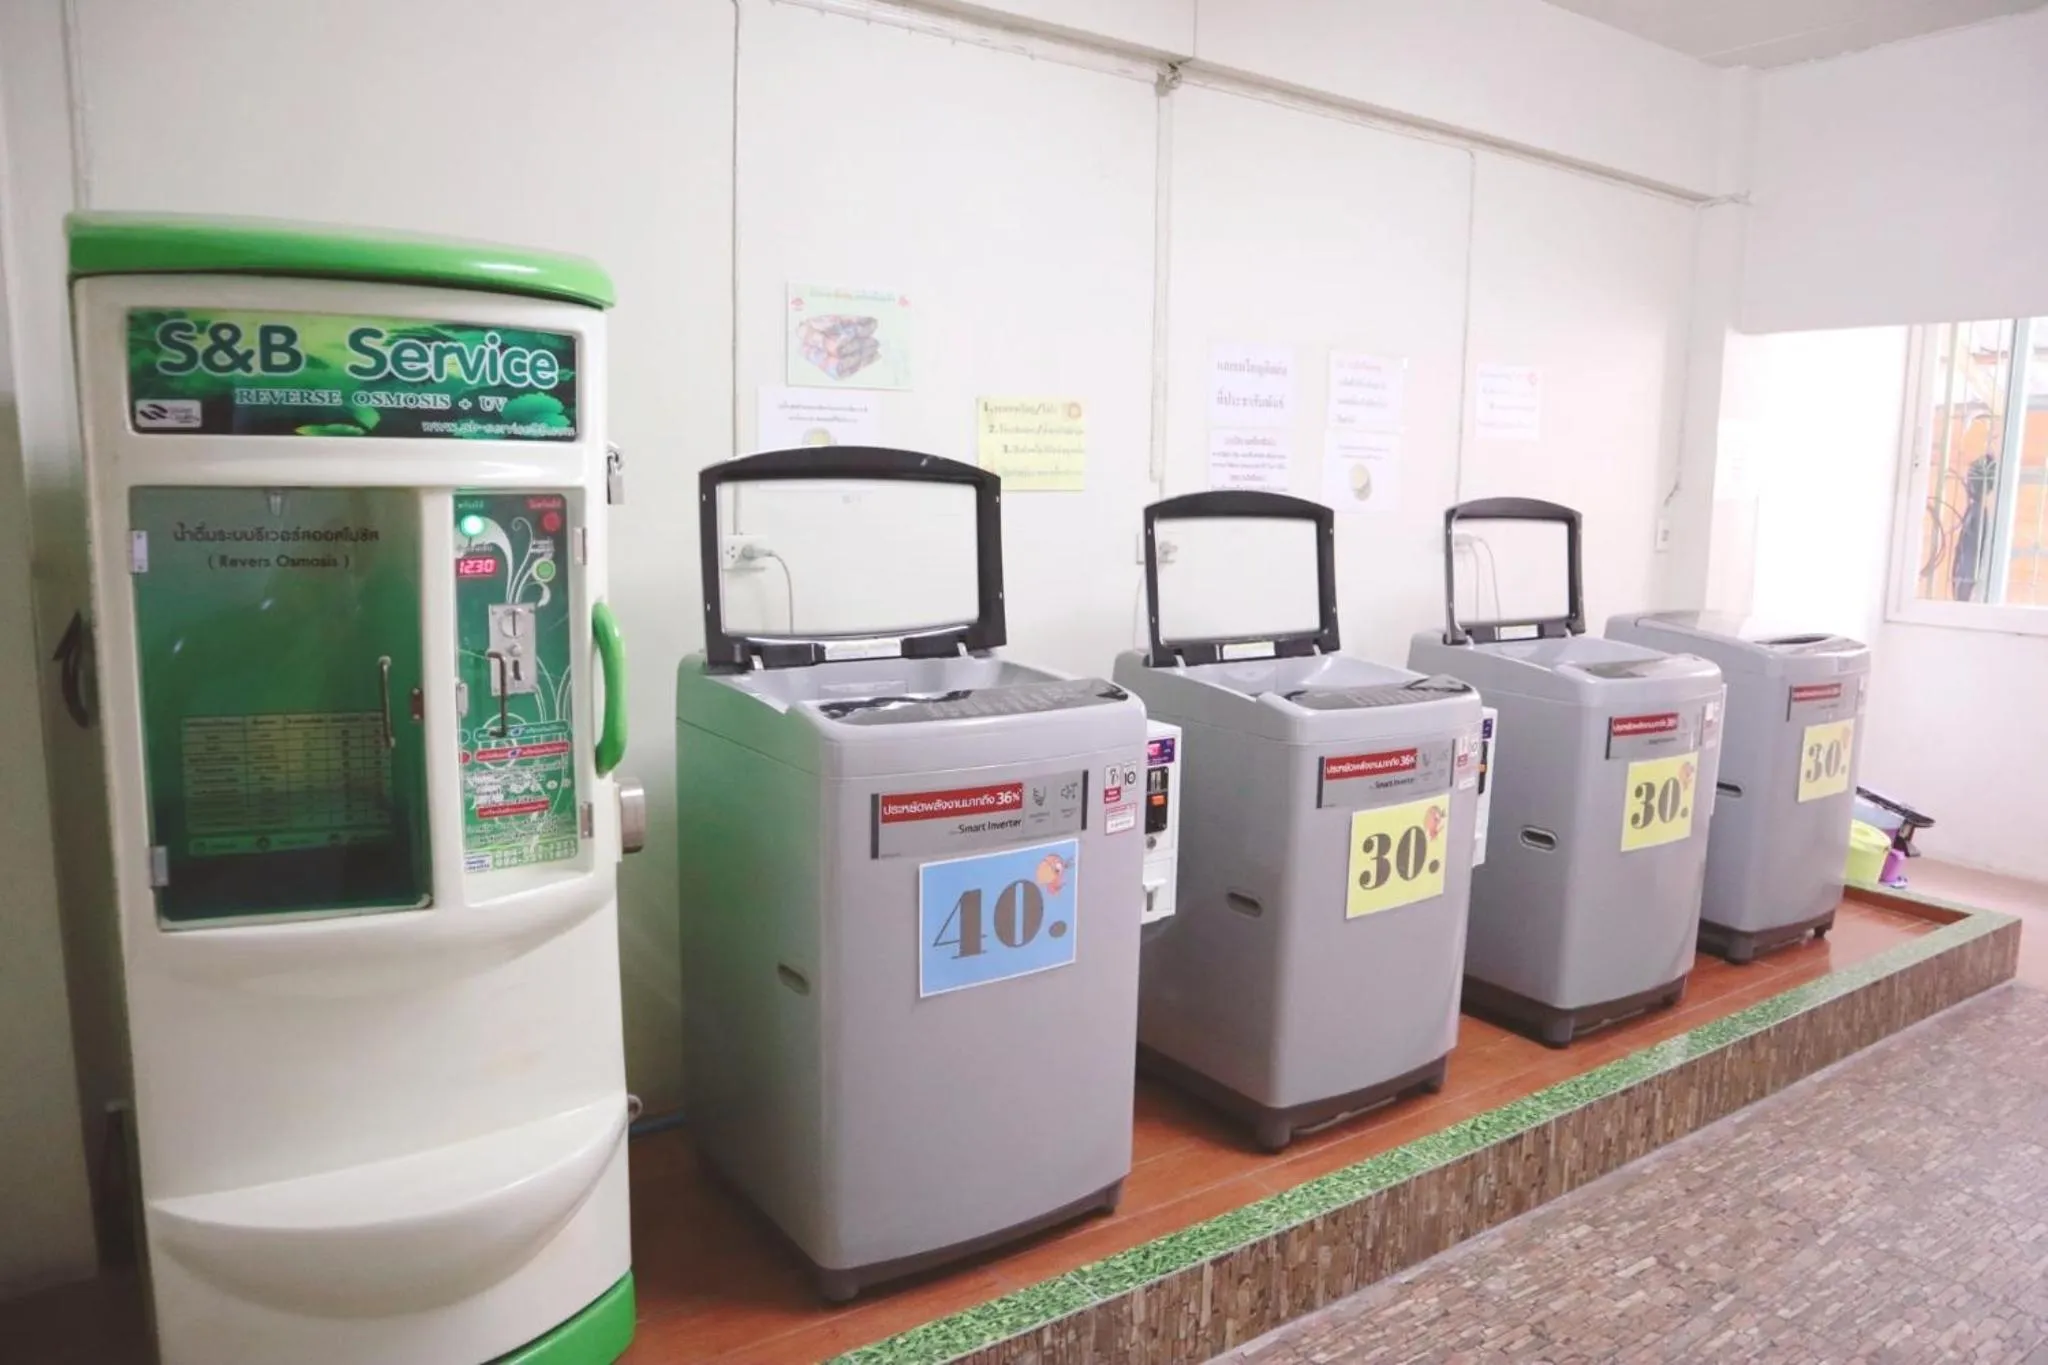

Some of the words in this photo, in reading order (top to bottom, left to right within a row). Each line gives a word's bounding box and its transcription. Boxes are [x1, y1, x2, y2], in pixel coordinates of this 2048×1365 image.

[156, 318, 304, 376] S&B
[347, 323, 559, 389] Service
[235, 387, 343, 407] REVERSE
[352, 390, 451, 410] OSMOSIS
[478, 395, 508, 412] UV
[276, 554, 338, 568] Osmosis
[958, 822, 986, 834] Smart
[988, 818, 1022, 830] Inverter
[1631, 777, 1688, 830] 30.
[1359, 826, 1440, 890] 30.
[933, 879, 1067, 959] 40.
